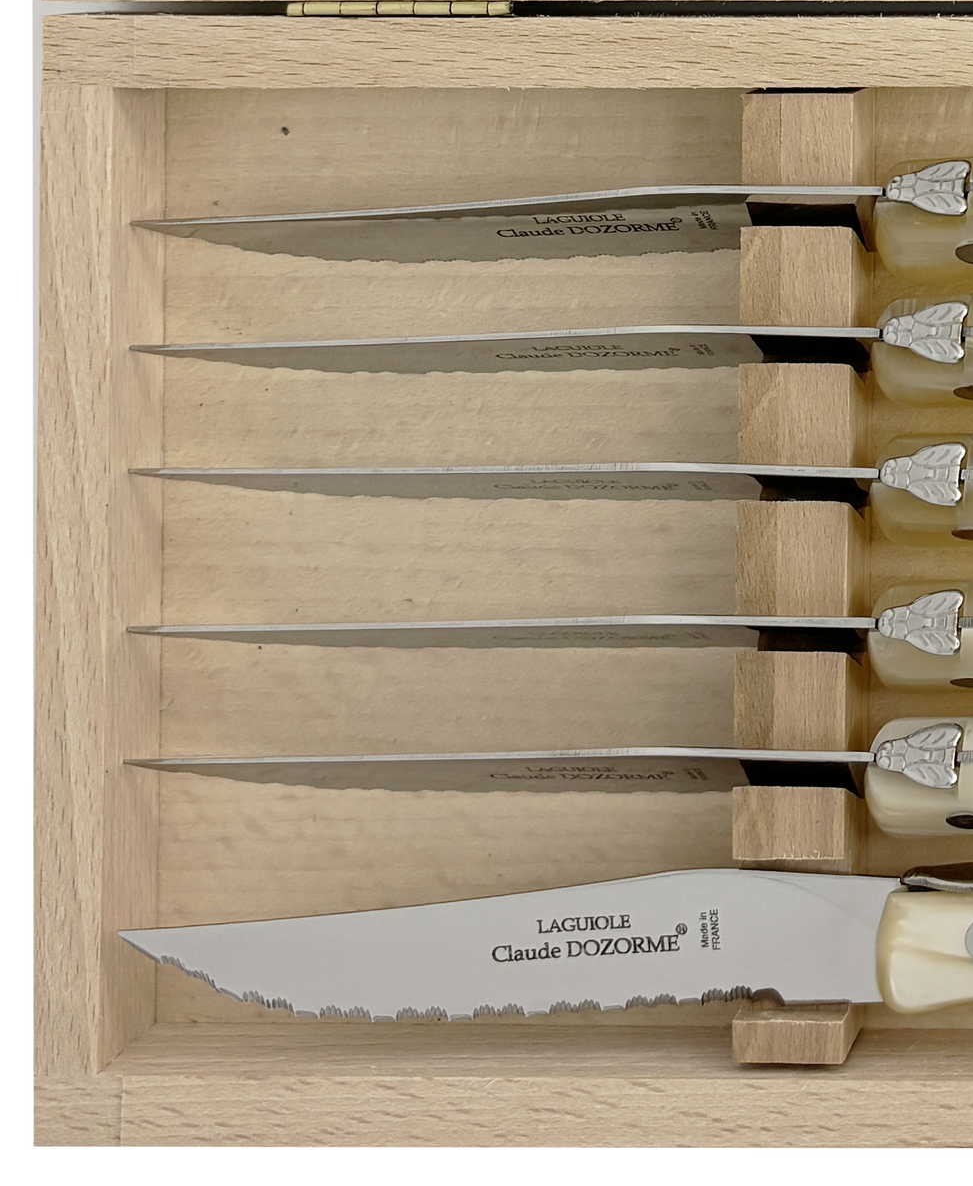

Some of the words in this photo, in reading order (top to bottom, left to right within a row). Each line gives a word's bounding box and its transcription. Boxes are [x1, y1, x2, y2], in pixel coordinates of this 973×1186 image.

[532, 213, 626, 225] LAGUIOLE
[496, 226, 565, 238] Claude
[536, 914, 631, 934] LAGUIOLE
[700, 911, 707, 921] in
[701, 924, 710, 949] Made
[709, 908, 722, 951] FRANCE
[491, 942, 562, 963] Claude
